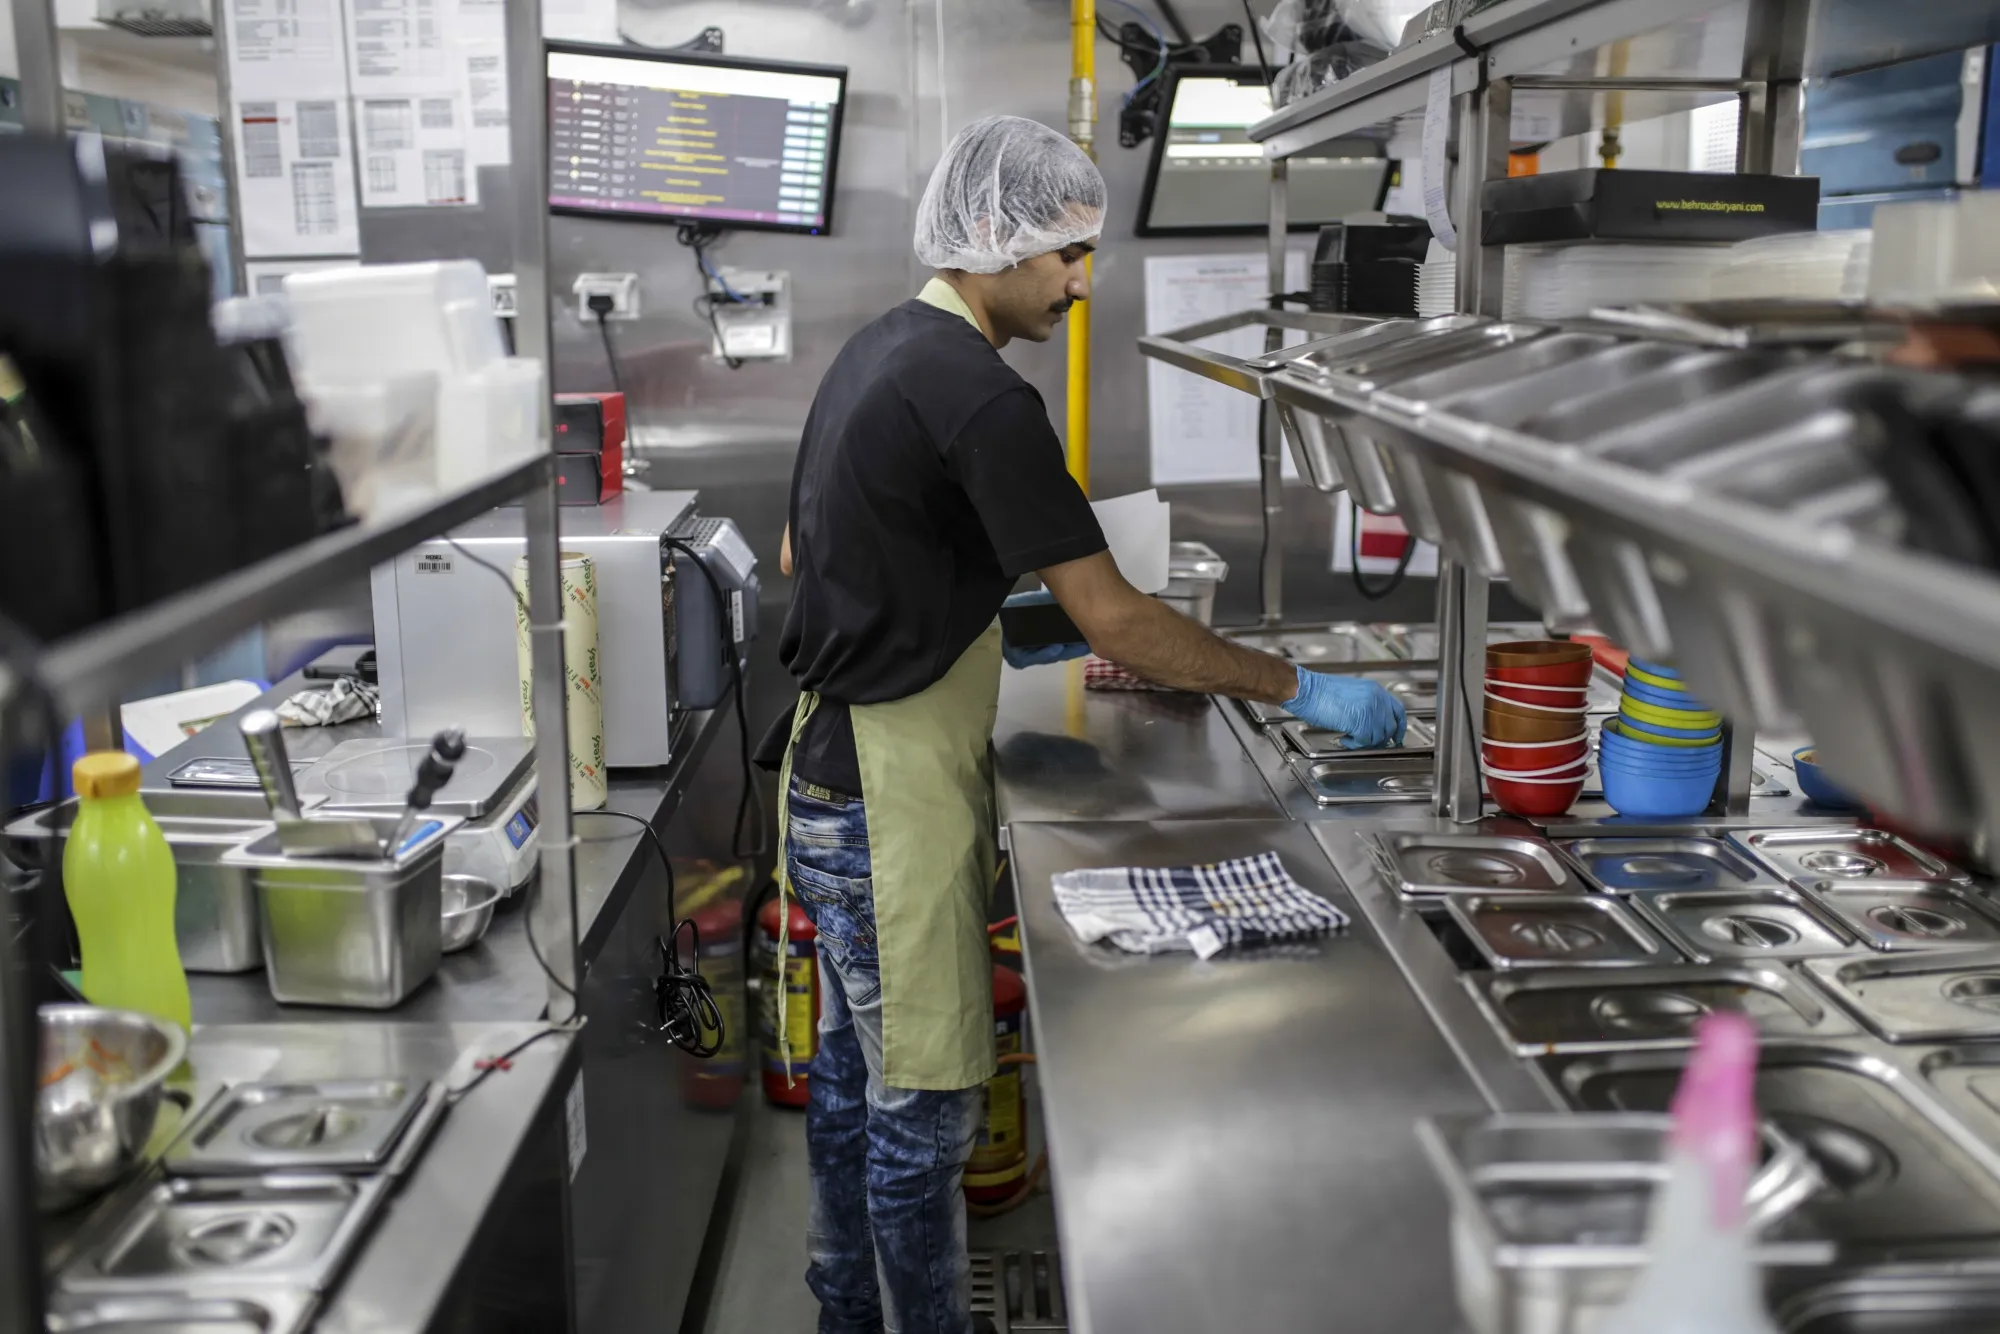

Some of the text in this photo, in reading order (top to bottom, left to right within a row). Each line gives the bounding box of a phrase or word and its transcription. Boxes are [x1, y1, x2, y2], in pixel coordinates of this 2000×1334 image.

[1656, 199, 1764, 213] www.behrouzbiryani.com
[587, 647, 597, 682] Fresh
[592, 734, 602, 769] Fresh
